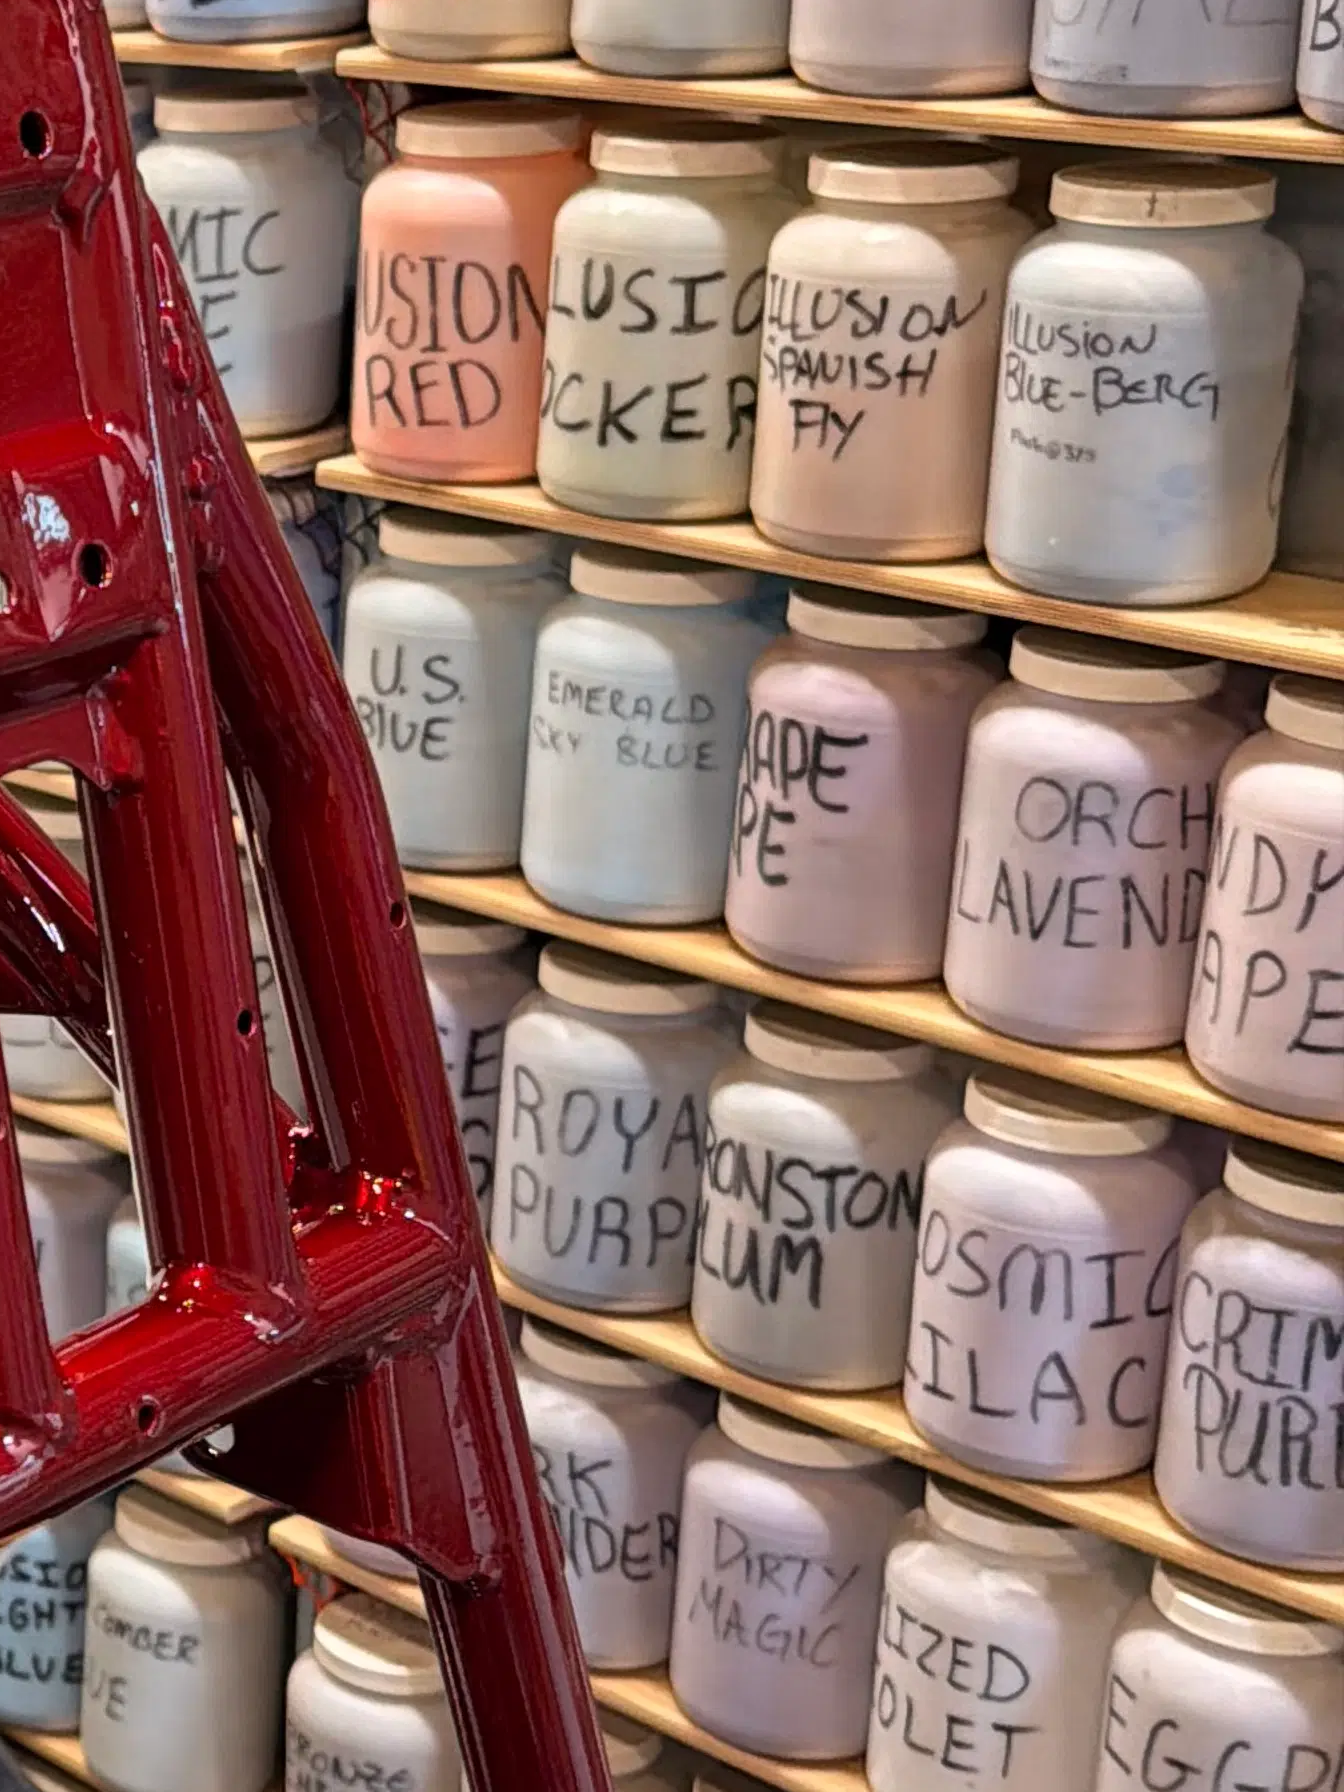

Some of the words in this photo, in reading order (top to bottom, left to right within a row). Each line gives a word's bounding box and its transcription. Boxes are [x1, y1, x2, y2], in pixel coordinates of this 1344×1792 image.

[364, 353, 503, 431] RED
[547, 670, 716, 725] EMERALD
[615, 729, 720, 772] BLUE
[742, 709, 869, 814] APE
[906, 1321, 1152, 1432] ILAC
[1182, 1361, 1344, 1490] PUR
[877, 1677, 1041, 1780] OLET
